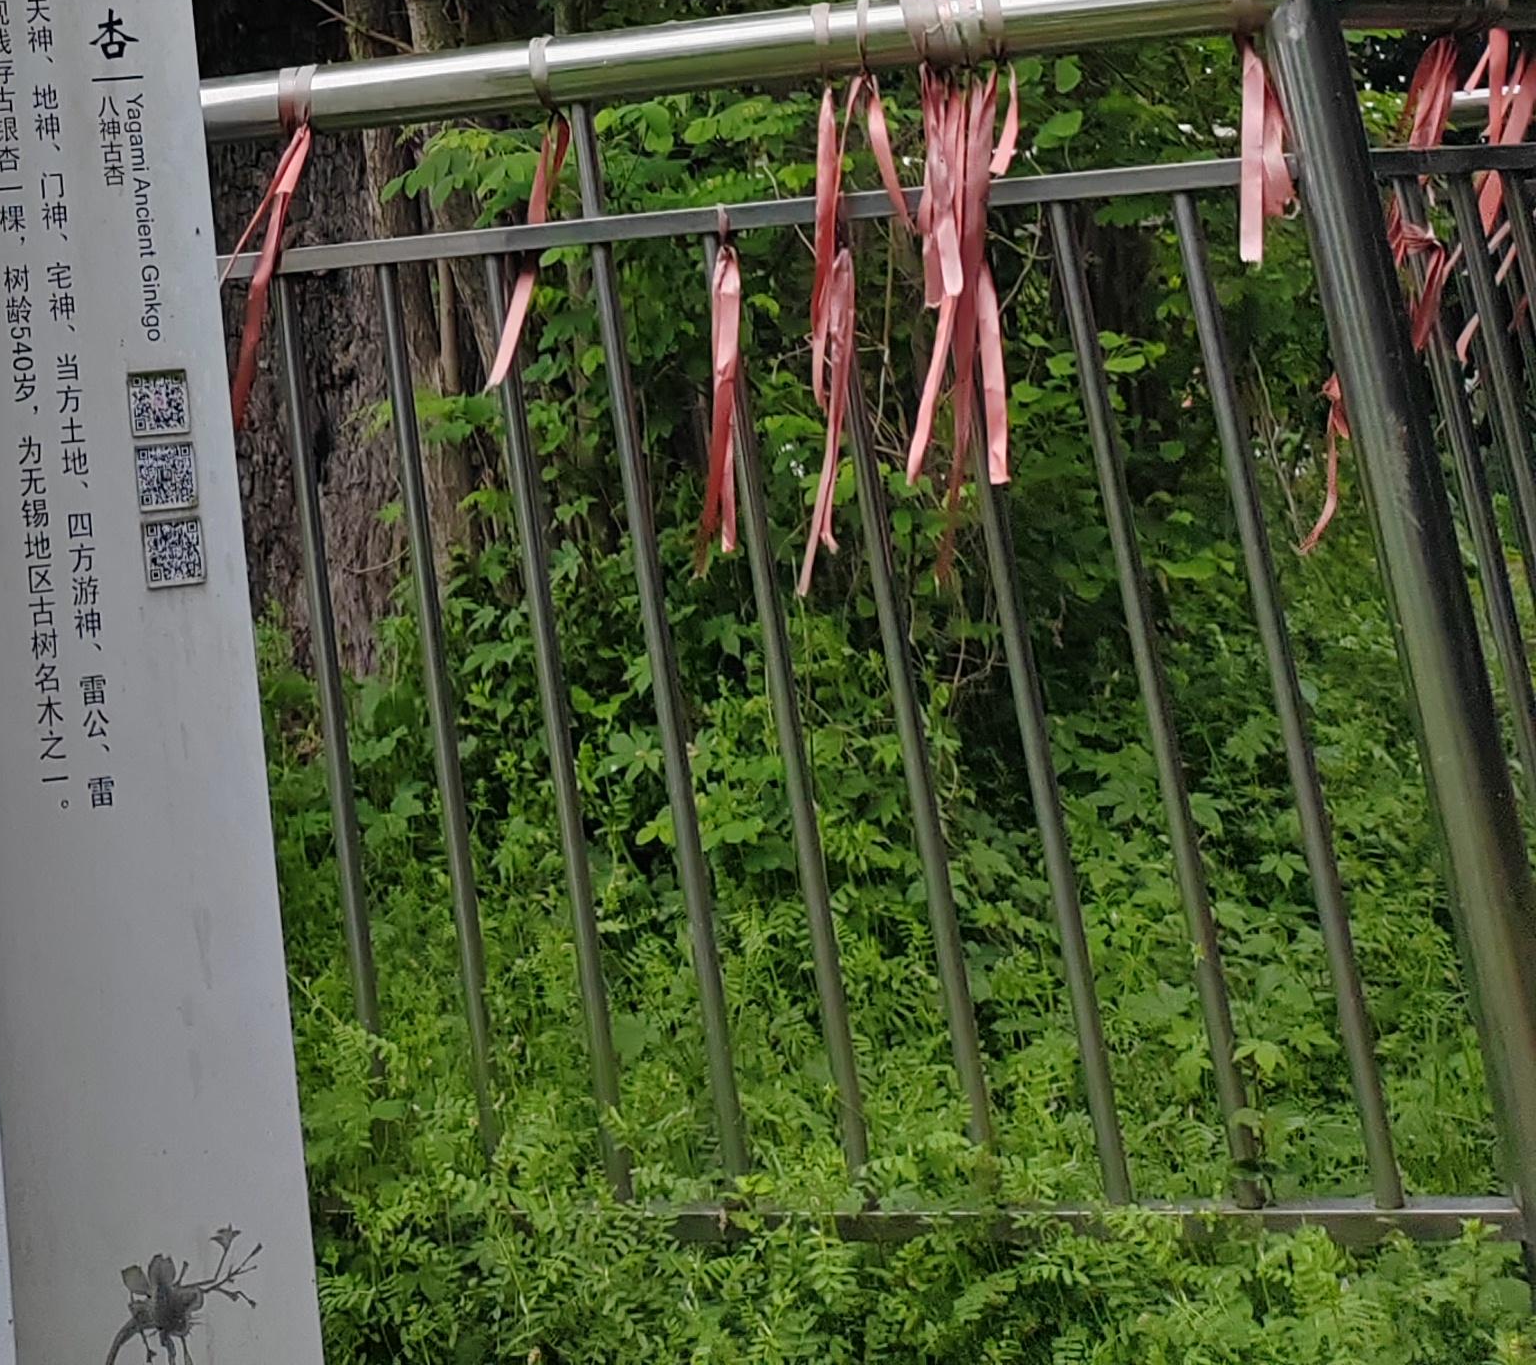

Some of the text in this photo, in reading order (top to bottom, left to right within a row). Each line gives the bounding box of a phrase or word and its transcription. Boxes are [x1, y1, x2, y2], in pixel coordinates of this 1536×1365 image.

[98, 95, 124, 187] 八神古杏
[125, 93, 162, 342] Yagami Ancient Ginkgo
